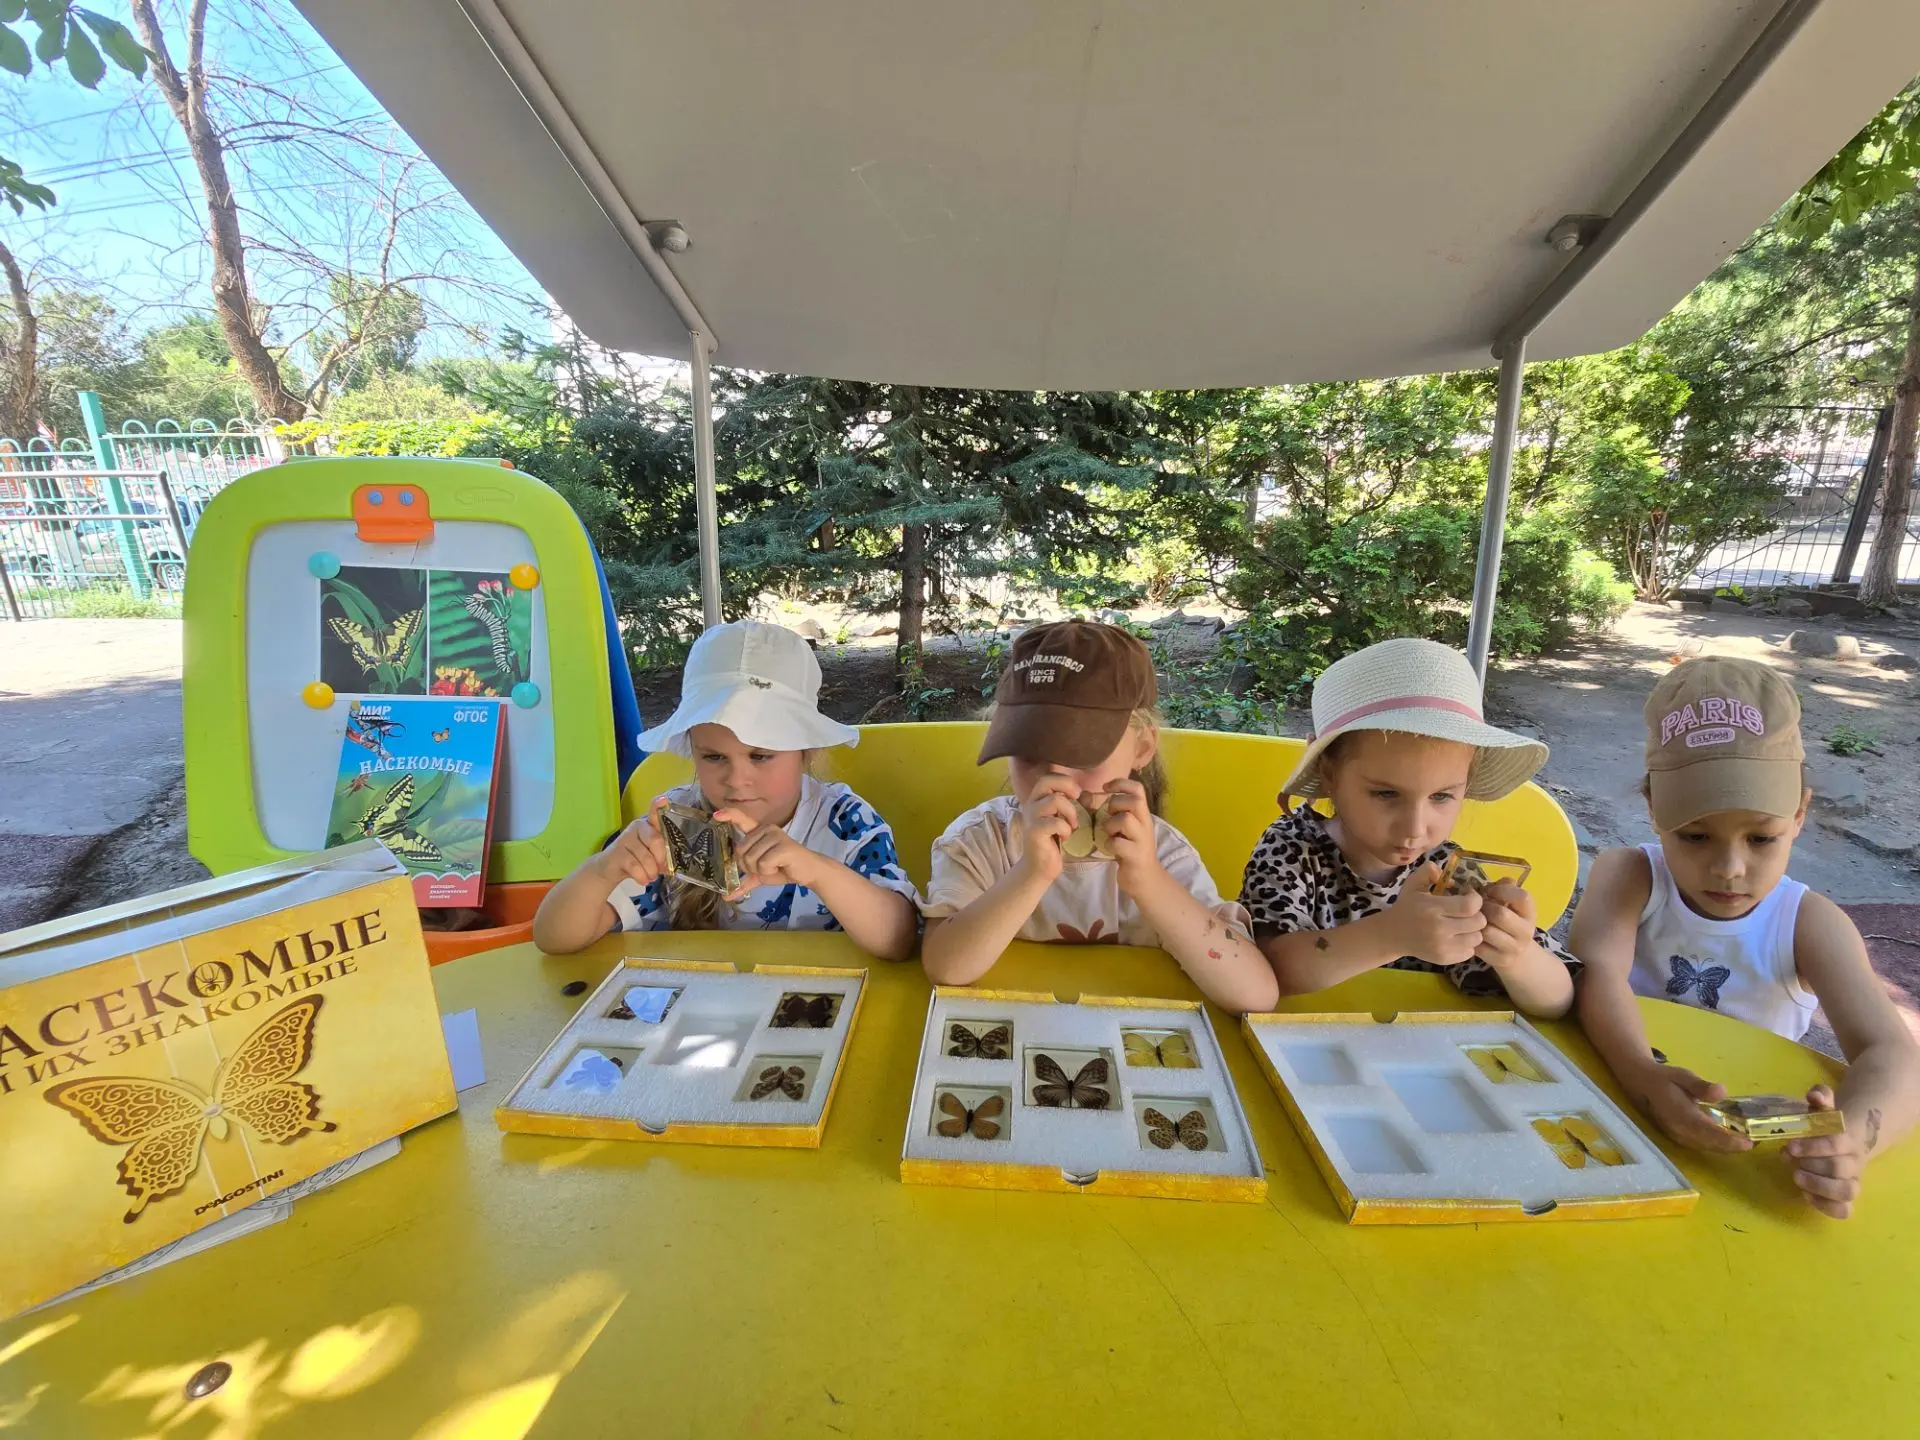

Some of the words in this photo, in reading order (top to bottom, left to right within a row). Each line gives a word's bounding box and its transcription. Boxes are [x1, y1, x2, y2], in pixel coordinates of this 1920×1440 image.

[1014, 658, 1033, 671] SAN
[358, 704, 392, 716] МИР
[453, 710, 489, 723] ФГОС
[1661, 697, 1765, 746] PARIS
[359, 756, 473, 776] НАСЕКОМЫЕ
[0, 908, 387, 1068] АСЕКОМЫЕ
[24, 1045, 97, 1086] ИХ
[105, 955, 358, 1057] ЗНАКОМЫЕ
